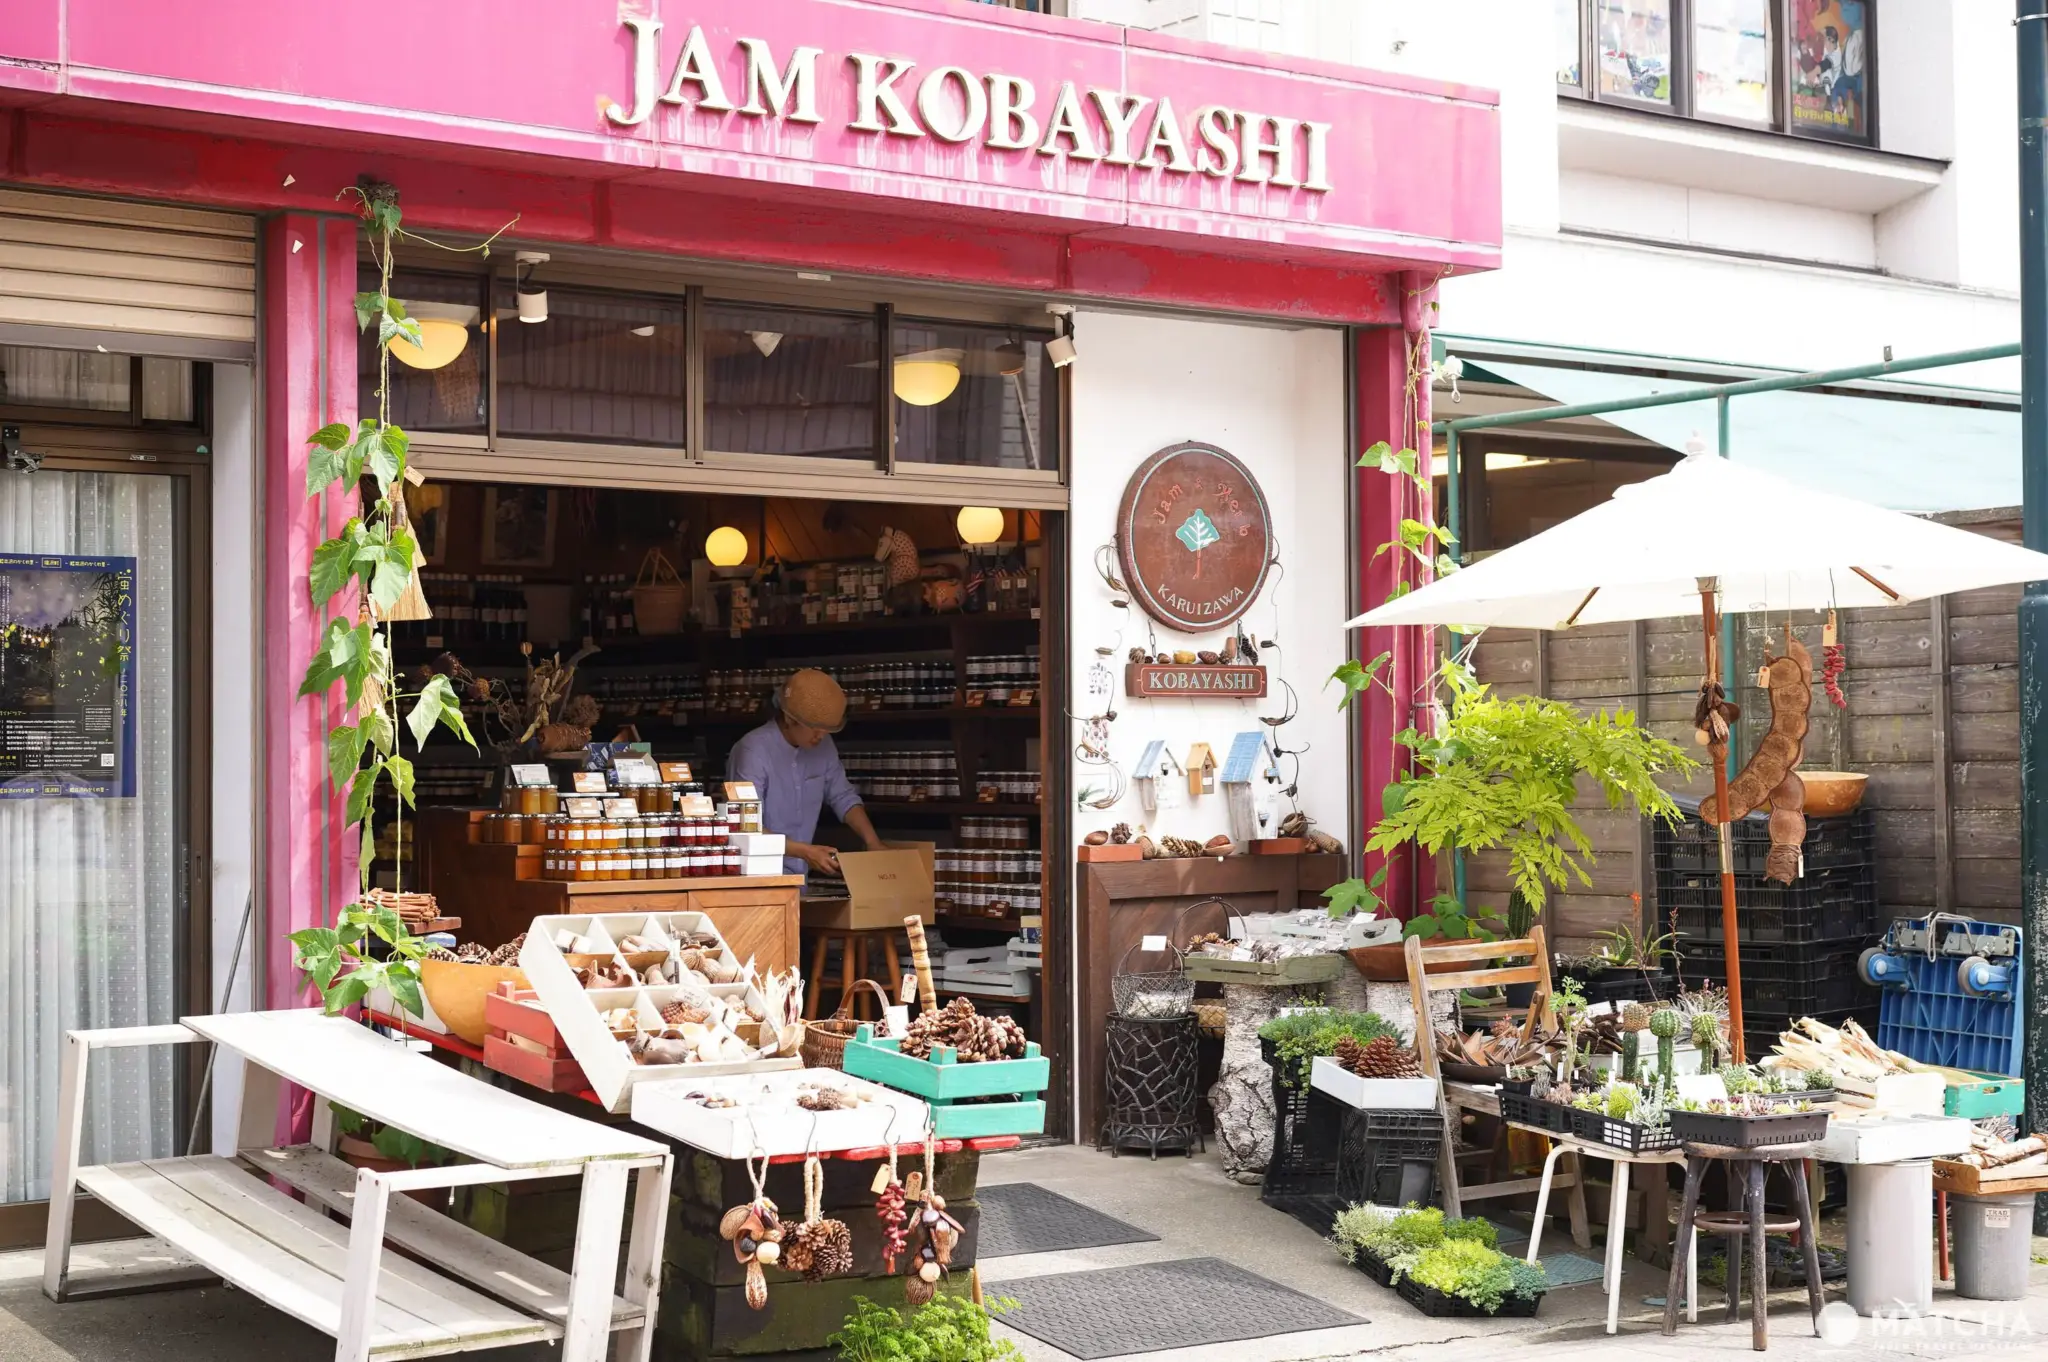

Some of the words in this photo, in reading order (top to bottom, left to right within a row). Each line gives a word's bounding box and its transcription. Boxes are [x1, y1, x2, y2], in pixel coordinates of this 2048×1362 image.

[604, 17, 825, 127] JAM
[845, 52, 1333, 193] KOBAYASHI
[1153, 484, 1183, 525] Jam
[117, 568, 132, 662] 蛍めぐり祭
[1157, 583, 1244, 616] KARUIZAWA
[1149, 672, 1254, 690] KOBAYASHI
